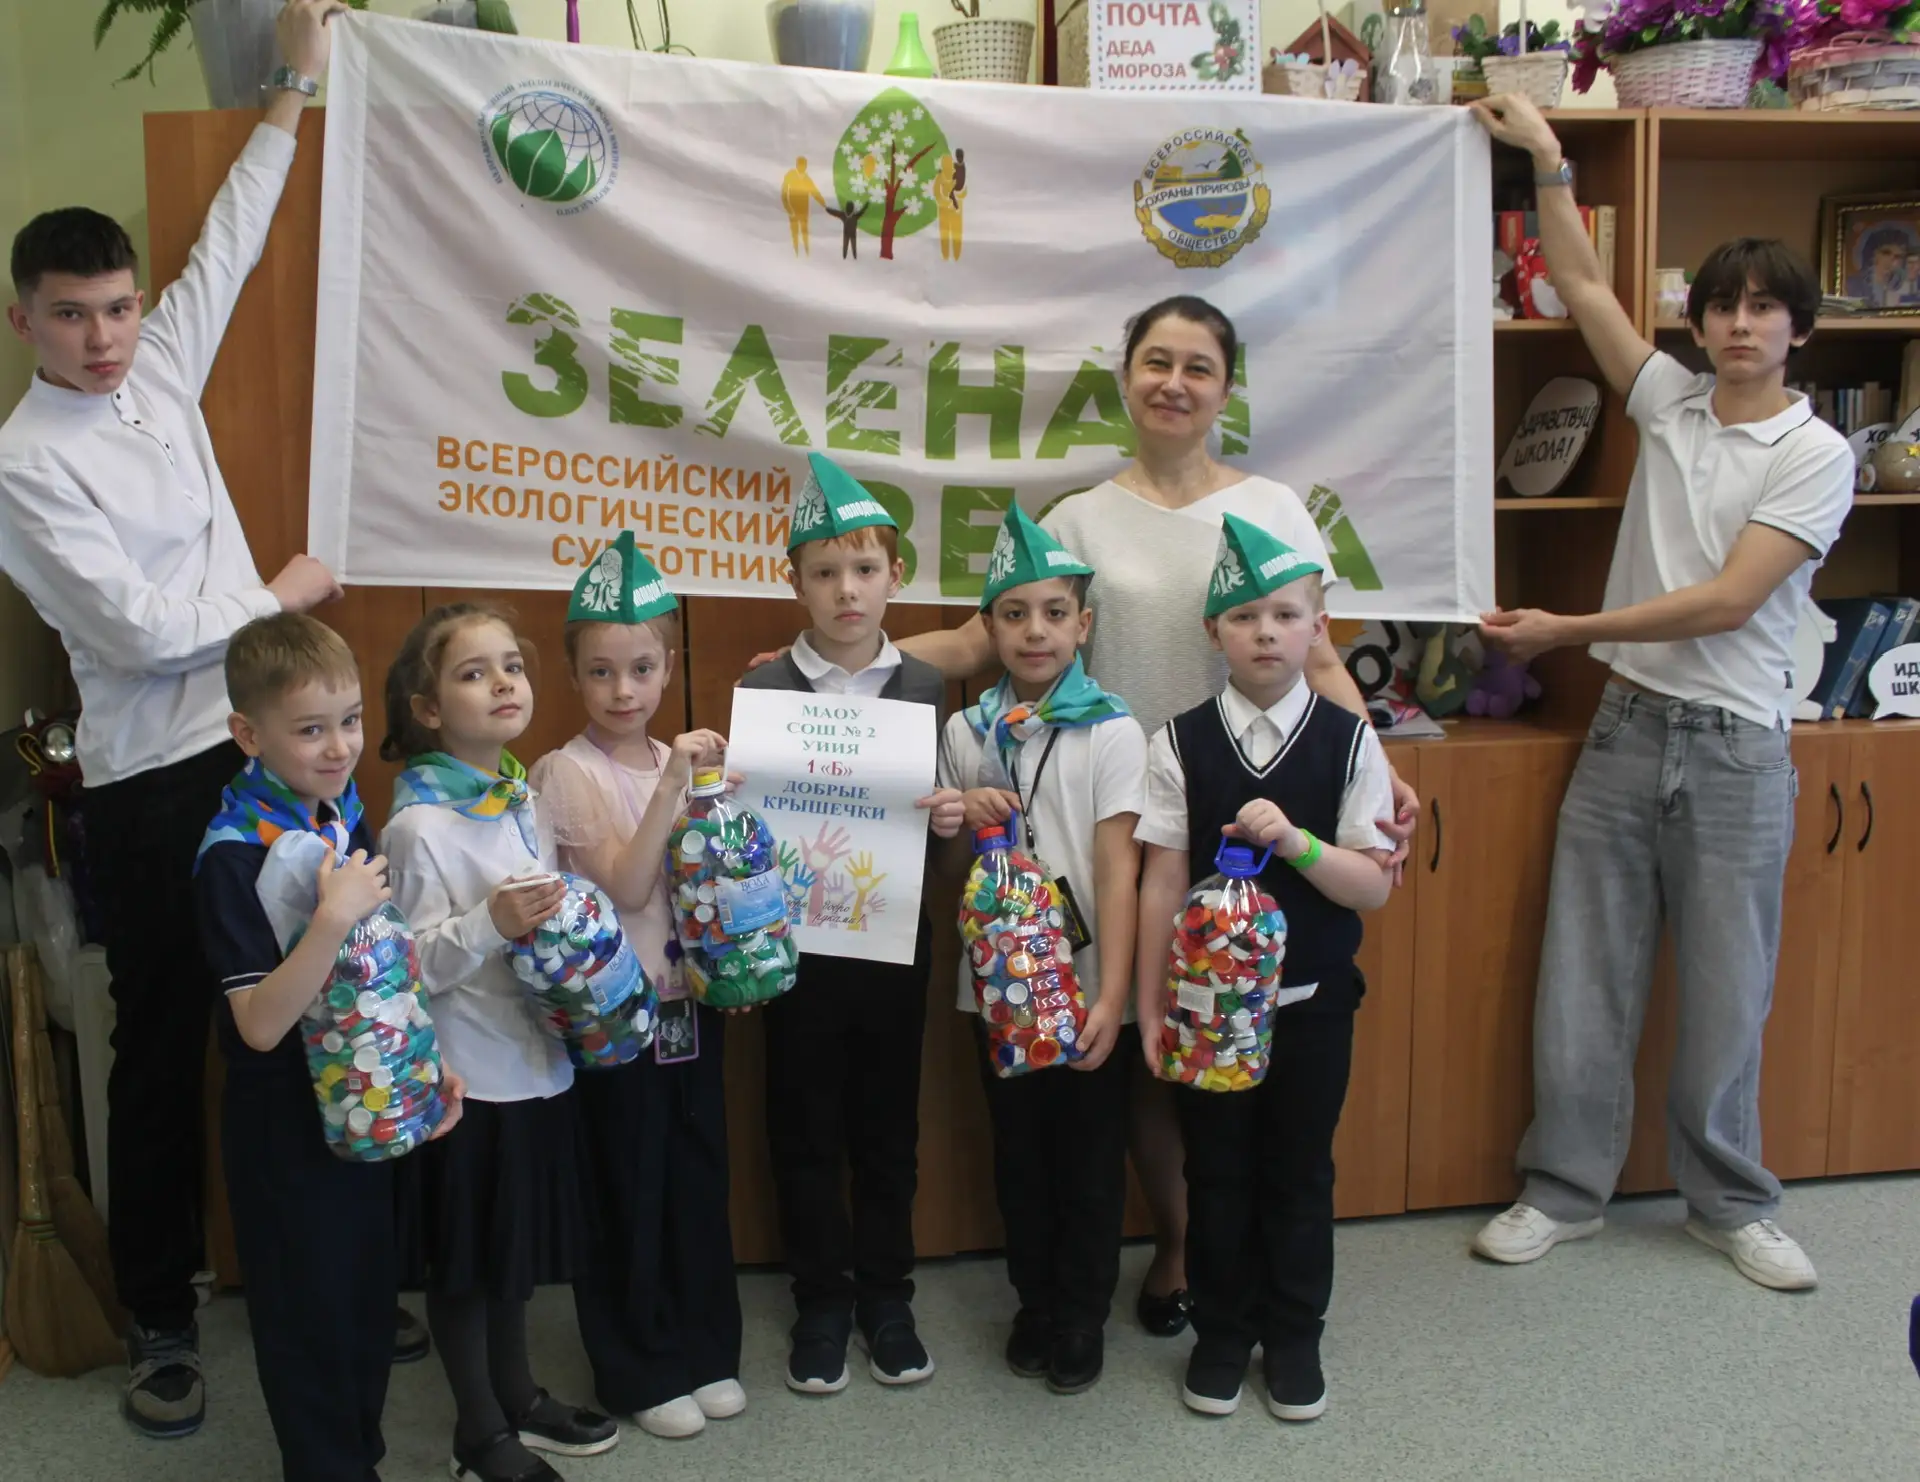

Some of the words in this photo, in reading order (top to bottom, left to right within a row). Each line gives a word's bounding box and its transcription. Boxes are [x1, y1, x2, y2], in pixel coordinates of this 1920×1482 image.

[1106, 2, 1201, 26] ПОЧТА
[1106, 40, 1155, 57] ДЕДА
[1108, 63, 1186, 78] МОРОЗА
[1144, 128, 1252, 180] ВСЕРОССИЙСКОЕ
[1145, 186, 1193, 206] ОХРАНЫ
[1196, 176, 1251, 196] ПРИРОДЫ
[1168, 229, 1238, 250] ОБЩЕСТВО
[1513, 436, 1575, 467] ШКОЛА!
[436, 435, 791, 504] ВСЕРОССИЙСКИЙ
[438, 480, 790, 548] ЭКОЛОГИЧЕСКИЙ
[552, 534, 793, 584] СУОТНИК
[1894, 661, 1920, 678] ИД
[801, 705, 864, 720] МАОУ
[787, 721, 836, 737] СОШ
[842, 726, 861, 738] №
[867, 727, 876, 738] 2
[807, 759, 815, 774] 1
[820, 760, 853, 776] «Б»
[783, 780, 870, 800] ДОБРЫЕ
[763, 795, 886, 820] КРЫШЕЧКИ
